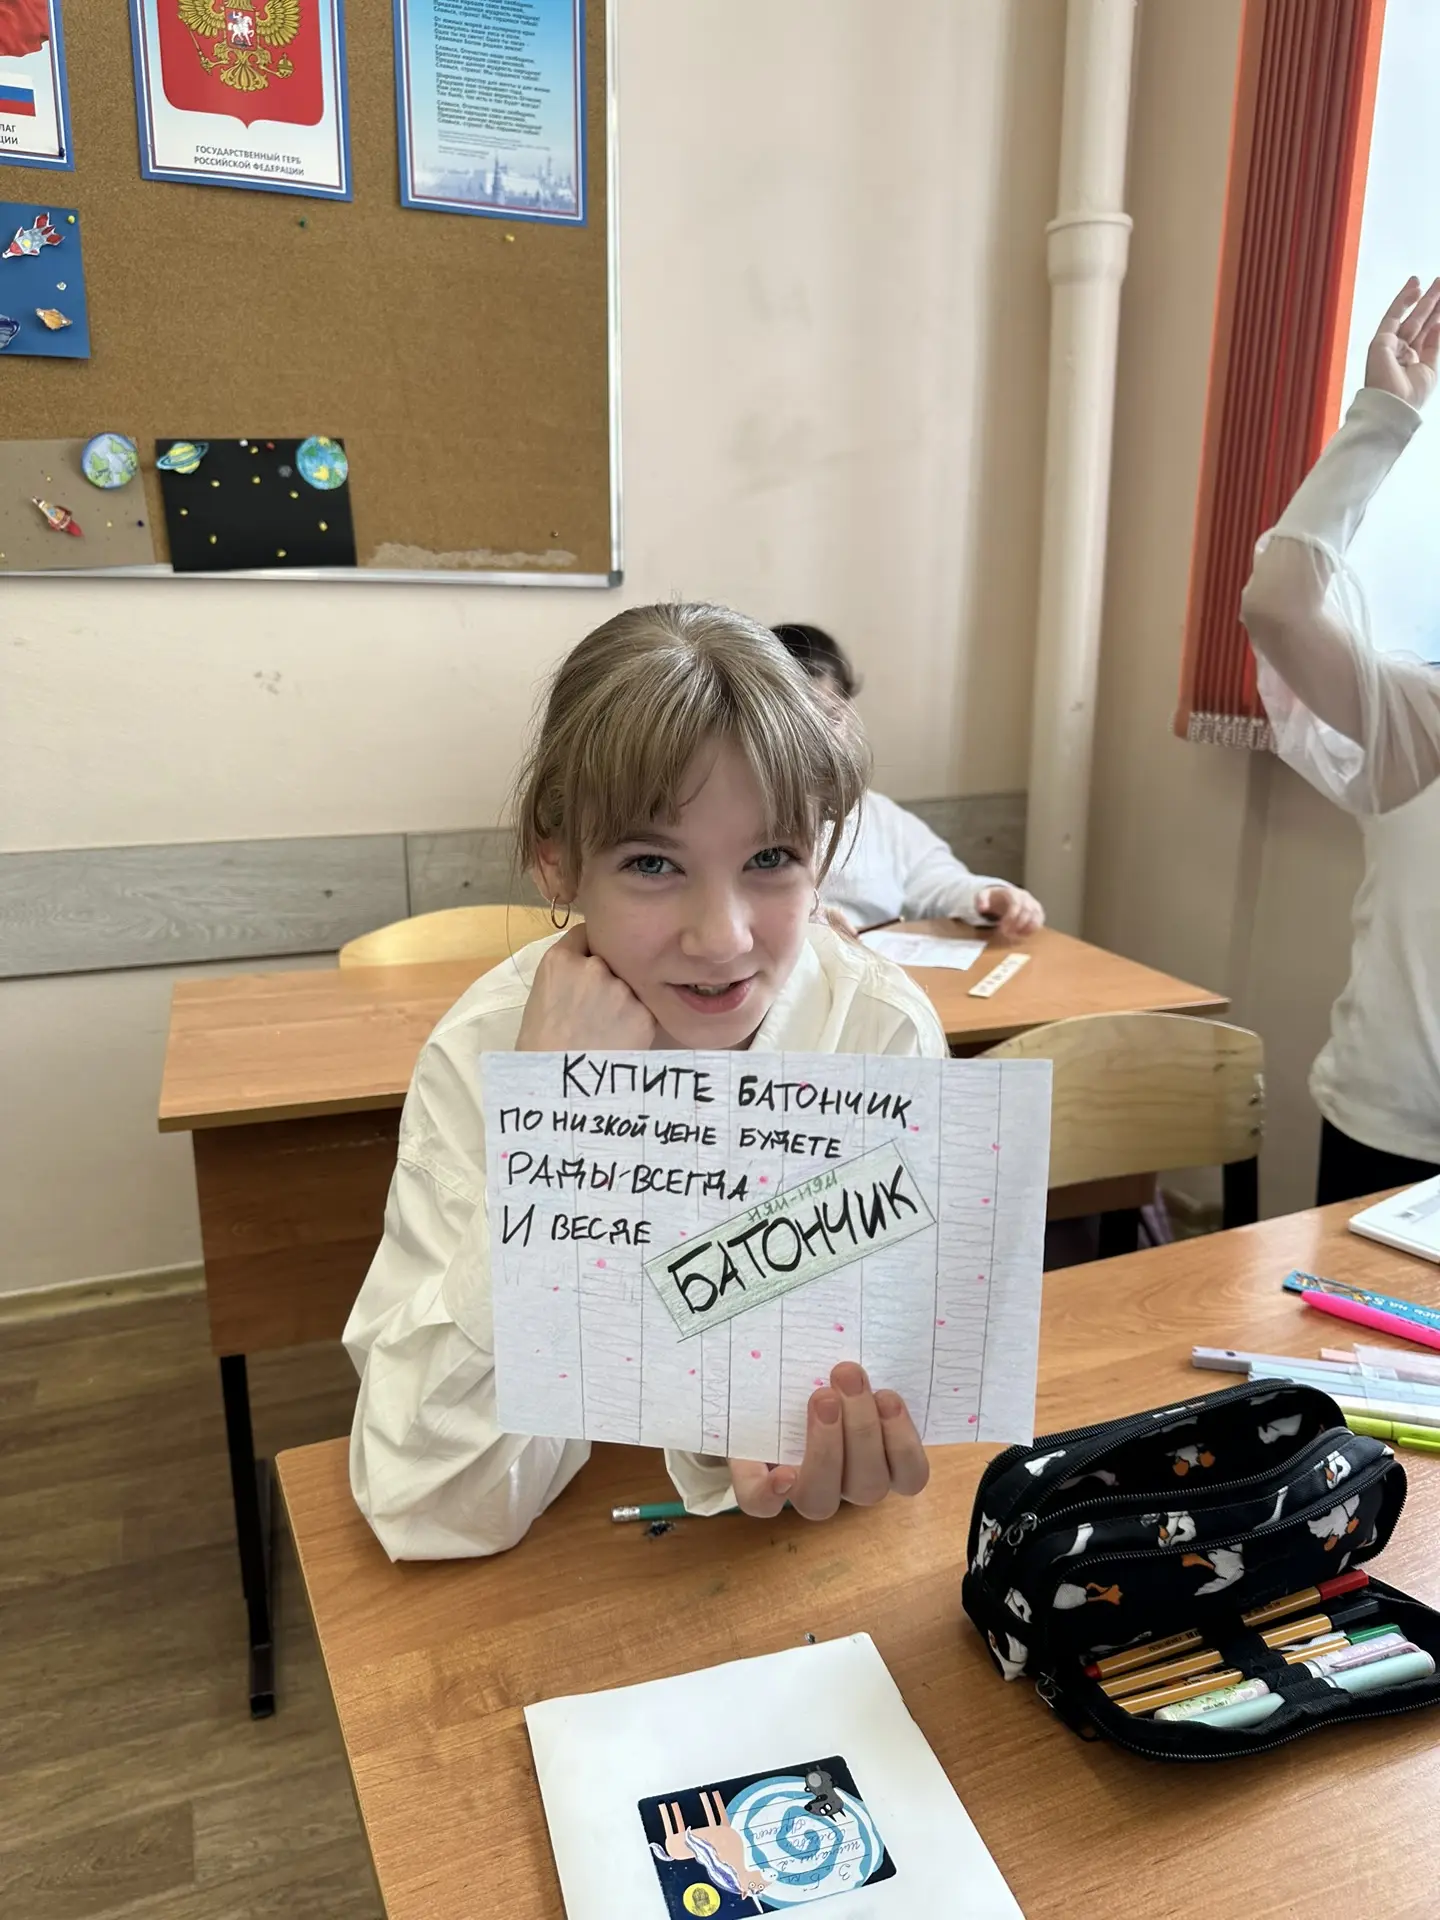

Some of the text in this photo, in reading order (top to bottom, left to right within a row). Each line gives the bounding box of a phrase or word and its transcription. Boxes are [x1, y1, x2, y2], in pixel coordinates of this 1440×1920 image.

[193, 156, 305, 176] РОССИЙСКОЙ ФЕДЕРАЦИИ
[195, 145, 302, 165] ГОСУДАРСТВЕННЫЙ ГЕРБ
[563, 1053, 914, 1129] КУПИТЕ БАТОНЧИК
[500, 1107, 843, 1159] ПО НИЗКОЙ ЦЕНЕ БУДЕТЕ
[502, 1203, 653, 1248] И ВЕСДЕ
[667, 1164, 919, 1315] БАТОНЧИК
